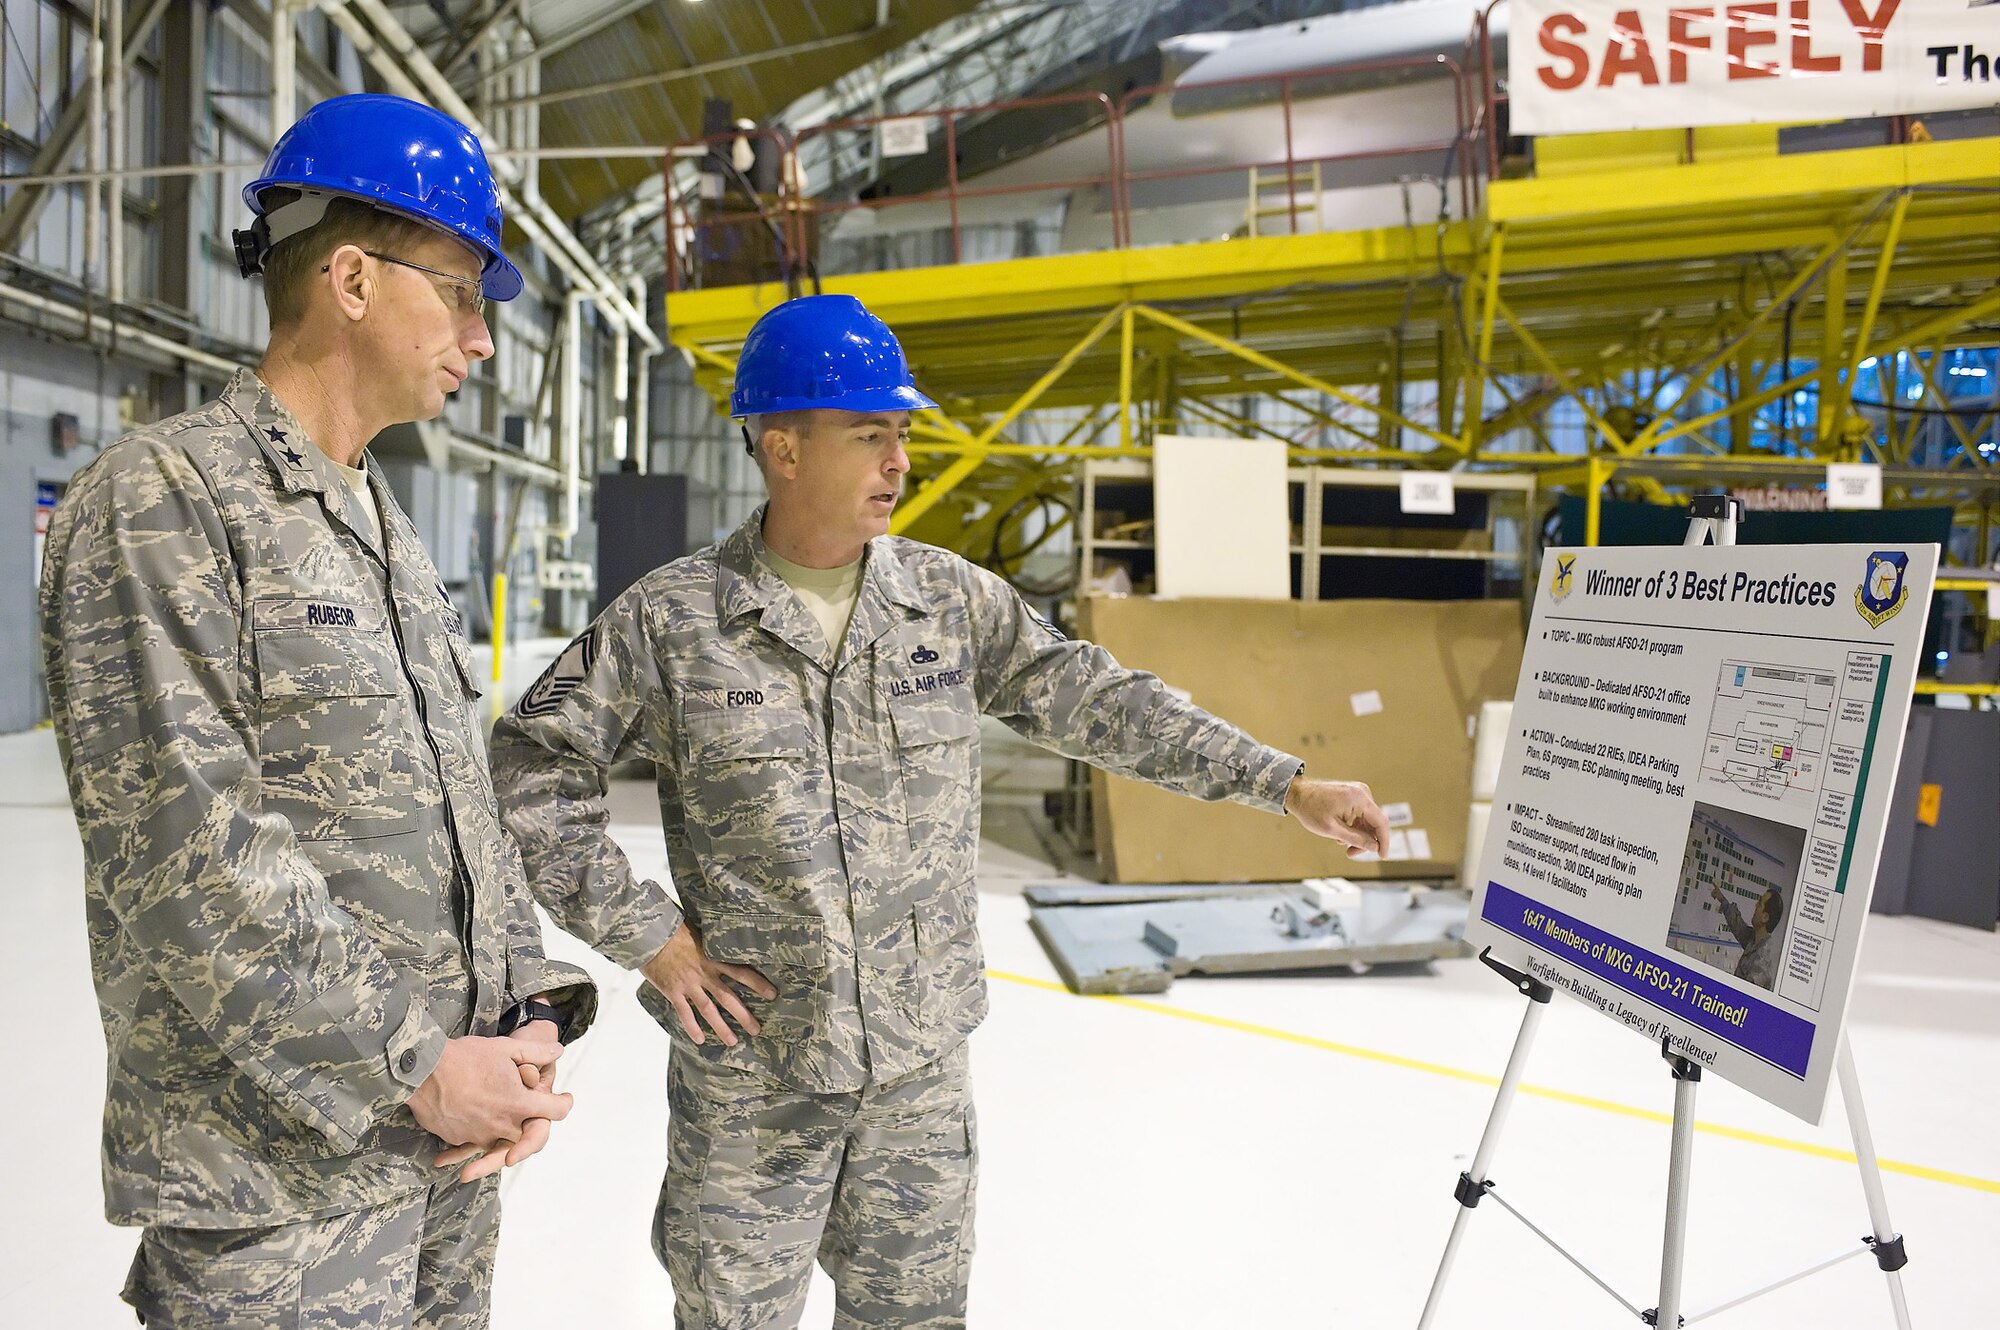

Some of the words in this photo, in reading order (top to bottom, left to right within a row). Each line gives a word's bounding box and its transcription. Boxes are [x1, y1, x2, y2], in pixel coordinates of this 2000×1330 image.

[1536, 0, 1900, 90] SAFELY
[1586, 569, 1642, 597] Winner
[1645, 570, 1666, 598] of
[1667, 571, 1678, 599] 3
[1682, 571, 1727, 601] Best
[1730, 571, 1837, 607] Practices
[307, 603, 357, 627] RUBEOR
[1550, 629, 1571, 643] TOPIC
[1576, 632, 1592, 645] MXG
[1593, 634, 1616, 648] robust
[1616, 636, 1648, 651] AFSO-21
[1649, 642, 1684, 657] program
[727, 690, 764, 706] FORD
[891, 680, 913, 697] U.S.
[915, 675, 935, 694] AIR
[937, 669, 964, 688] FORCE
[1542, 670, 1590, 689] BACKGROUND
[1596, 679, 1632, 696] Dedicated
[1632, 684, 1667, 701] AFSO-21
[1667, 689, 1691, 706] office
[1538, 687, 1552, 700] built
[1552, 691, 1560, 702] to
[1560, 692, 1588, 708] enhance
[1588, 696, 1606, 711] MXG
[1607, 701, 1635, 720] working
[1636, 707, 1687, 726] environment
[1522, 764, 1550, 781] practices
[1526, 745, 1541, 761] Plan,
[1542, 749, 1552, 762] 6S
[1551, 754, 1580, 772] program,
[1581, 759, 1598, 774] ESC
[1597, 765, 1629, 786] planning
[1630, 773, 1664, 795] meeting,
[1666, 780, 1685, 798] best
[1529, 728, 1555, 745] ACTION
[1560, 735, 1597, 755] Conducted
[1597, 744, 1607, 757] 22
[1607, 746, 1626, 763] RIEs,
[1627, 750, 1647, 768] IDEA
[1648, 755, 1680, 777] Parking
[1510, 820, 1522, 834] ISO
[1522, 826, 1551, 845] customer
[1552, 836, 1579, 858] support,
[1580, 847, 1611, 867] reduced
[1610, 854, 1628, 871] flow
[1628, 861, 1637, 877] in
[1514, 803, 1539, 821] IMPACT
[1545, 813, 1586, 837] Streamlined
[1586, 826, 1599, 842] 280
[1600, 831, 1615, 848] task
[1616, 836, 1659, 865] inspection,
[1503, 853, 1521, 872] ideas,
[1522, 861, 1531, 874] 14
[1530, 865, 1546, 881] level
[1546, 871, 1551, 883] 1
[1550, 873, 1588, 898] facilitators
[1506, 838, 1537, 858] munitions
[1537, 849, 1562, 870] section,
[1563, 858, 1576, 874] 300
[1576, 863, 1595, 881] IDEA
[1595, 871, 1625, 896] parking
[1624, 882, 1643, 900] plan
[1522, 908, 1546, 931] 1647
[1544, 918, 1591, 954] Members
[1591, 942, 1606, 960] of
[1604, 946, 1633, 973] MXG
[1632, 960, 1689, 1000] AFSO-21
[1691, 984, 1749, 1028] Trained!
[1526, 955, 1571, 989] Warfighters
[1570, 978, 1608, 1011] Building
[1608, 1001, 1615, 1010] a
[1616, 1002, 1648, 1031] Legacy
[1648, 1022, 1661, 1038] of
